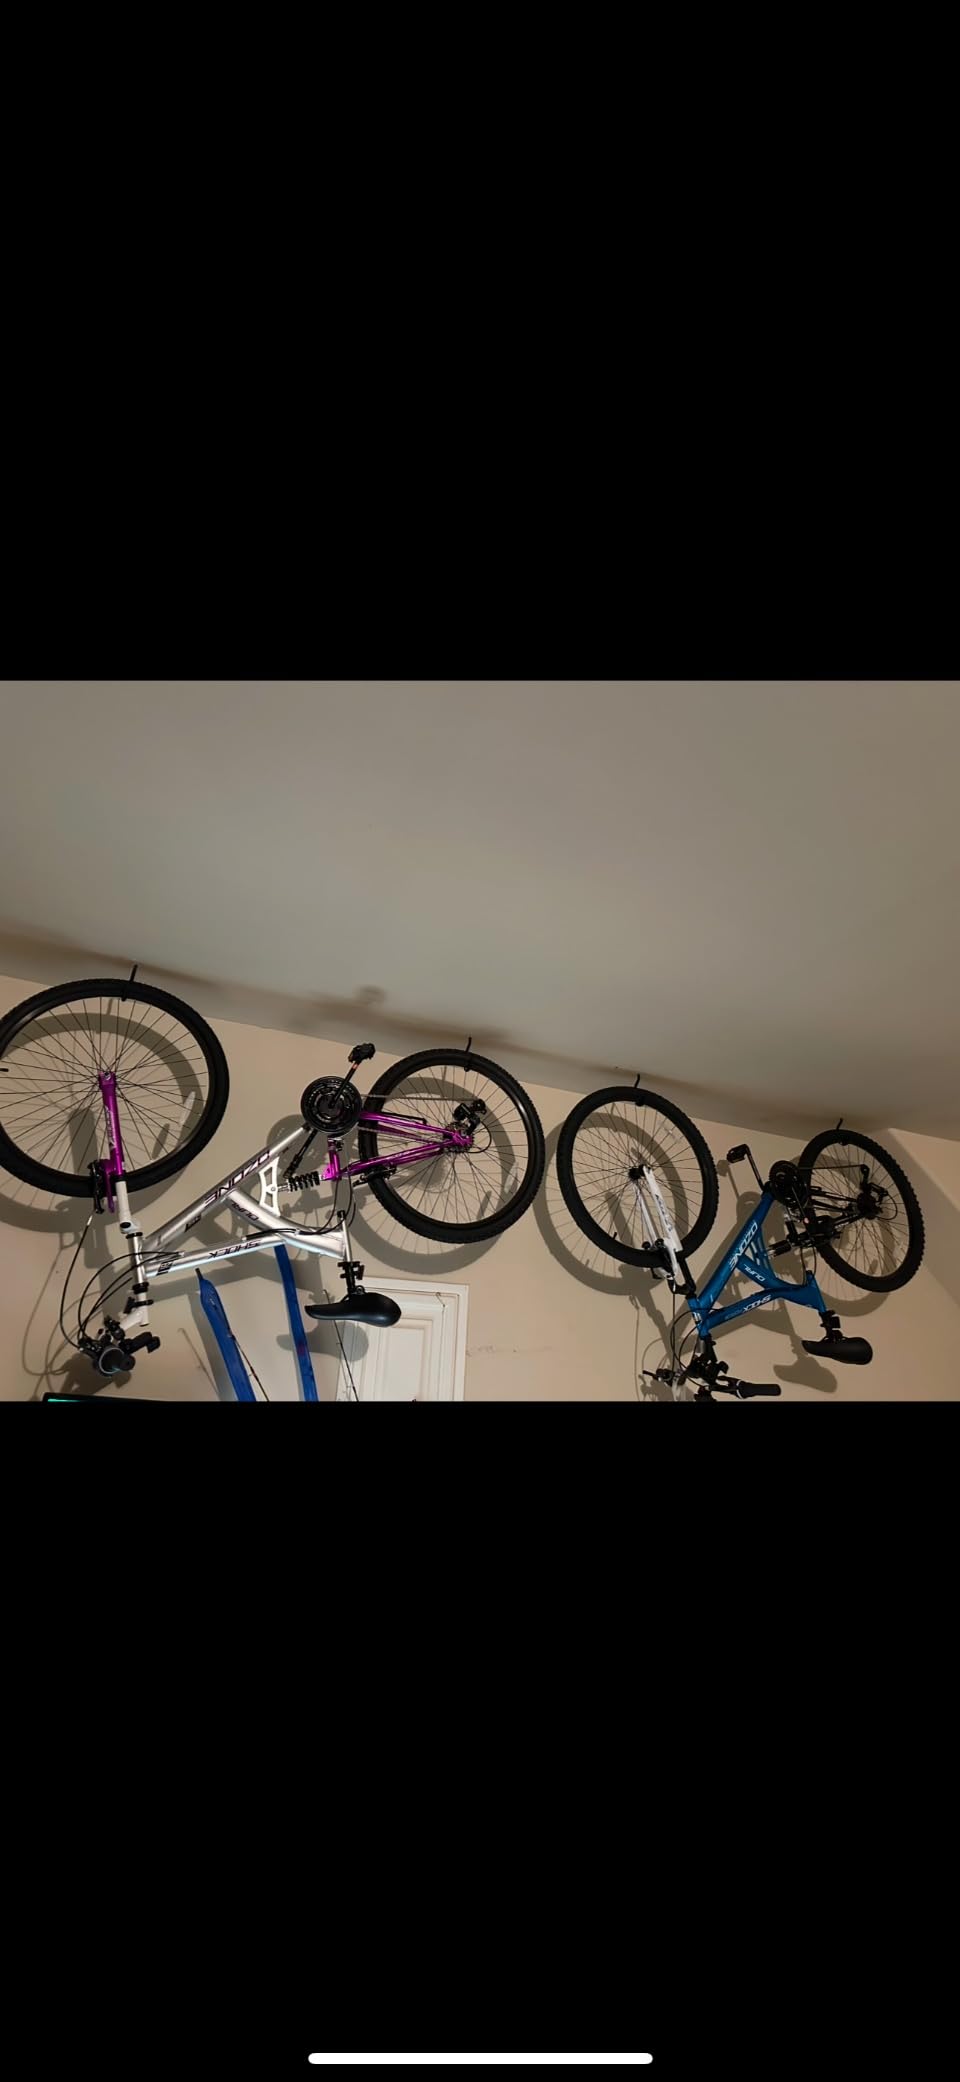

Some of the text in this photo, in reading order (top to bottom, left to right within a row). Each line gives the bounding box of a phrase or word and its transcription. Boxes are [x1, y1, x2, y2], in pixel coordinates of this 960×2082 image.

[204, 1149, 271, 1207] OZONE
[231, 1201, 260, 1221] DUAL
[208, 1240, 261, 1259] SHOCK
